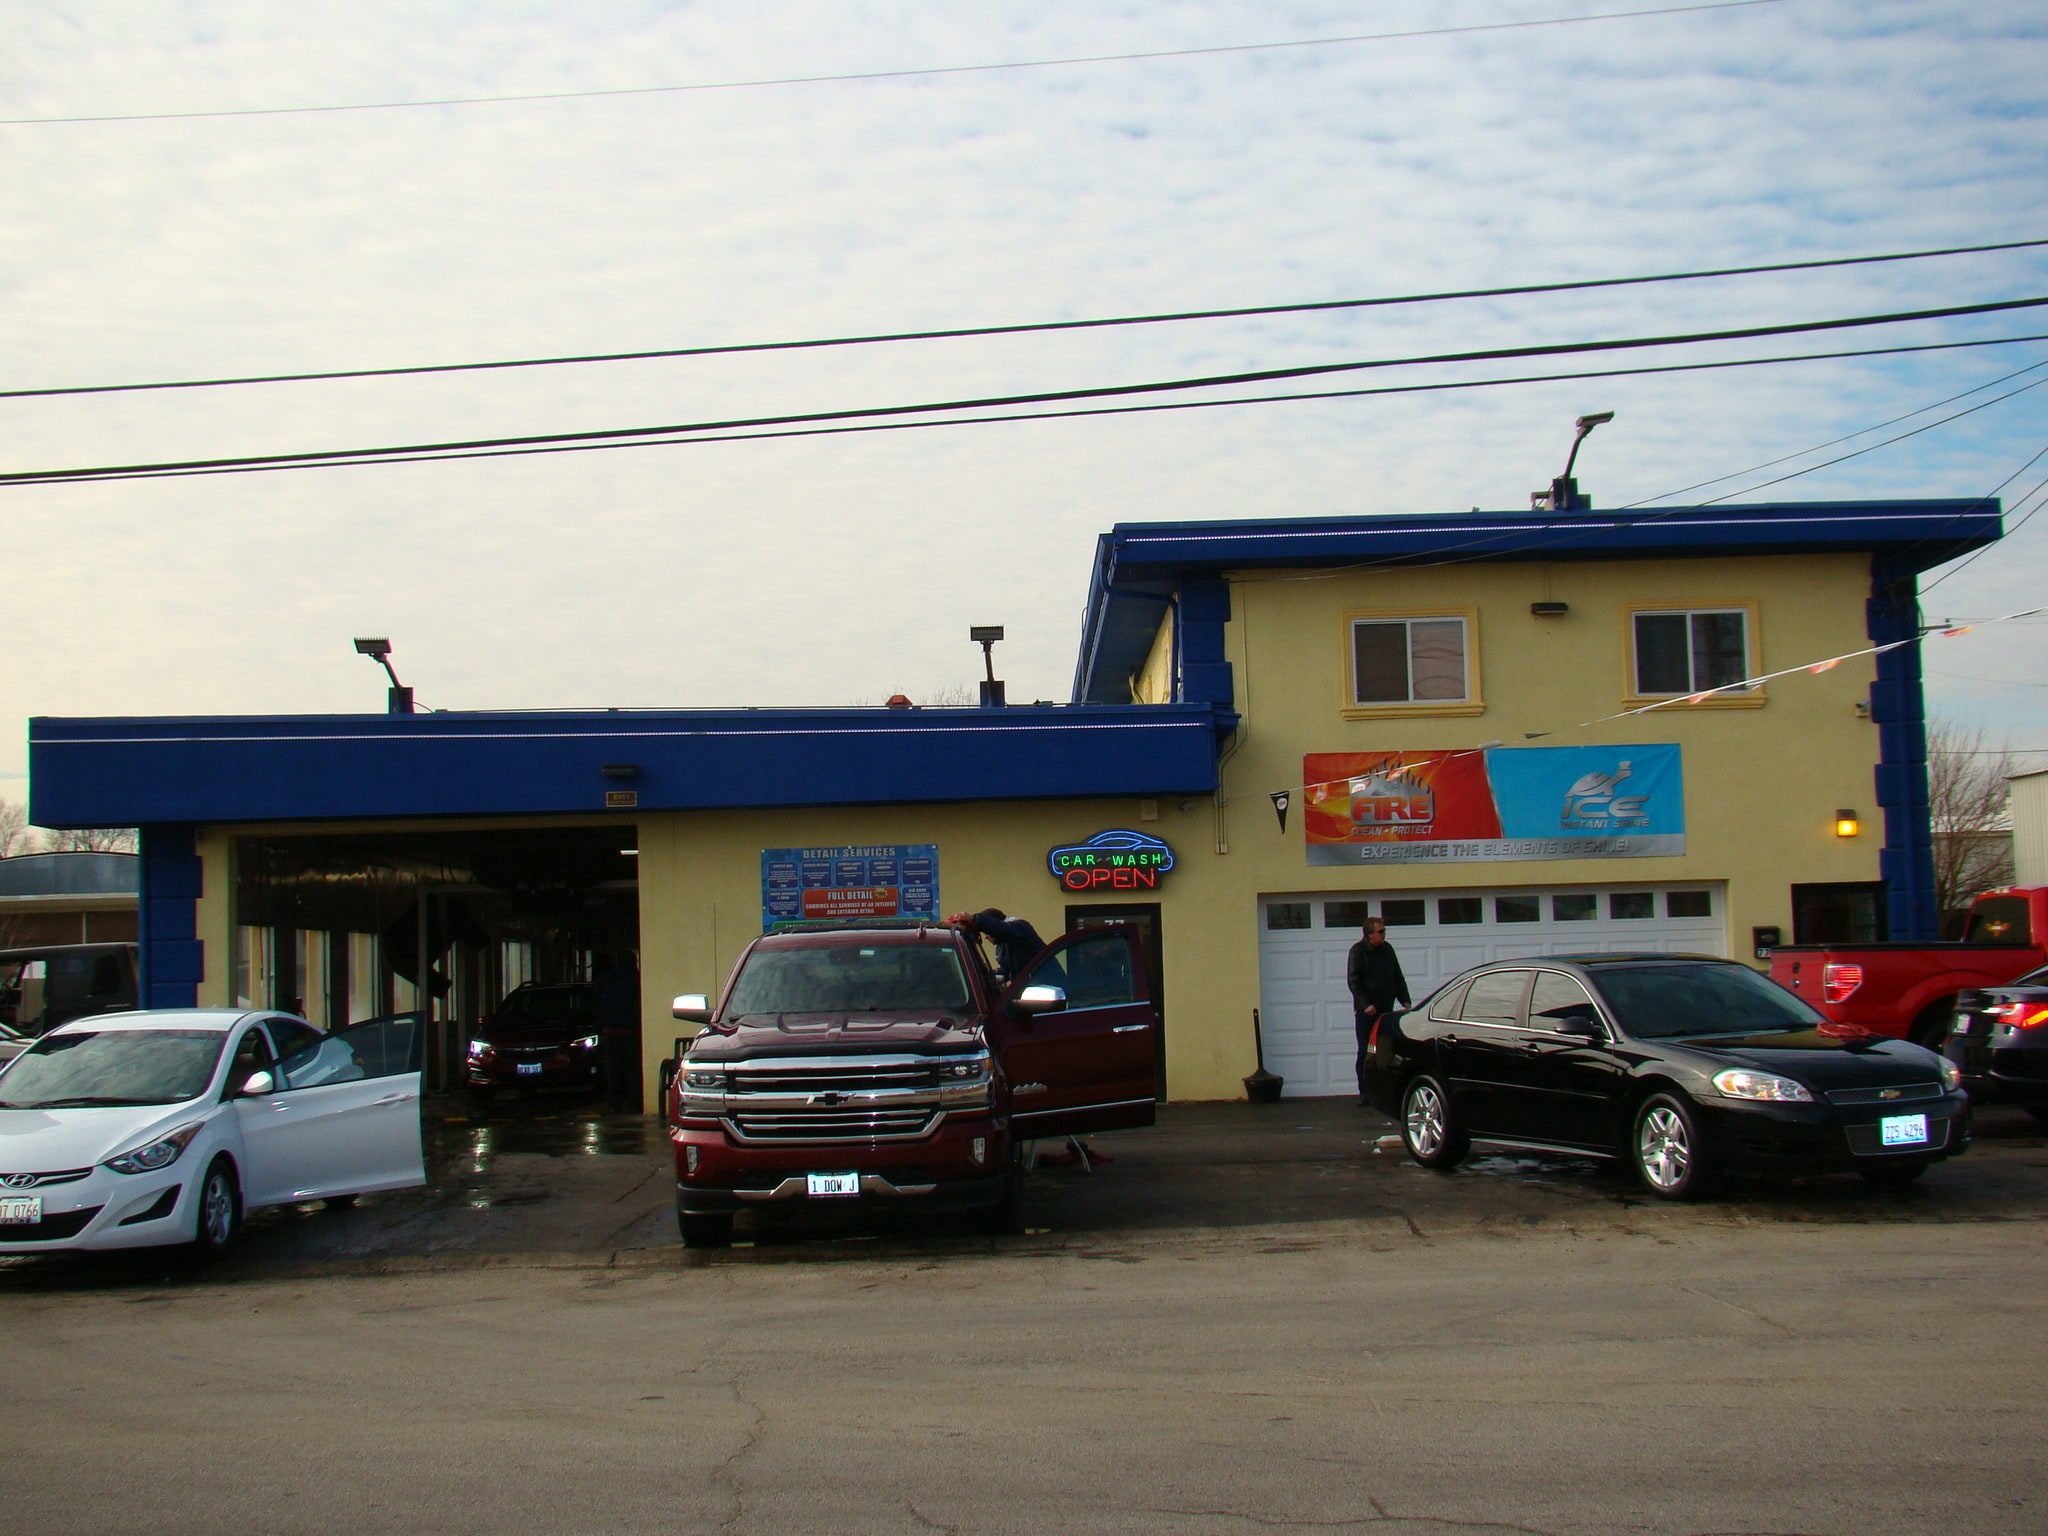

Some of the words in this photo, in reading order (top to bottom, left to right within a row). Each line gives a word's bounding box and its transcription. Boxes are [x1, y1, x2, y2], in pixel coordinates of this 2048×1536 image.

[1353, 797, 1431, 821] FIRE
[1560, 796, 1651, 819] ICE
[1351, 826, 1383, 836] CLEAN
[1392, 825, 1434, 835] PROTECT
[1560, 819, 1609, 831] INSTANT
[1612, 818, 1650, 829] SHINE
[803, 849, 839, 859] DETAIL
[843, 847, 896, 858] SERVICES
[1361, 845, 1448, 860] EXPERIENCE
[1453, 843, 1480, 857] THE
[1484, 841, 1557, 857] ELEMENTS
[1562, 841, 1582, 854] OF
[1584, 840, 1630, 853] SHINE!
[1061, 854, 1096, 867] CAR
[1112, 853, 1162, 866] WASH
[1065, 867, 1155, 889] OPEN
[828, 891, 845, 900] FULL
[847, 890, 873, 900] DETAIL
[812, 1180, 818, 1192] 1
[824, 1179, 842, 1192] DOW
[849, 1179, 855, 1191] J
[14, 1204, 39, 1217] 0766
